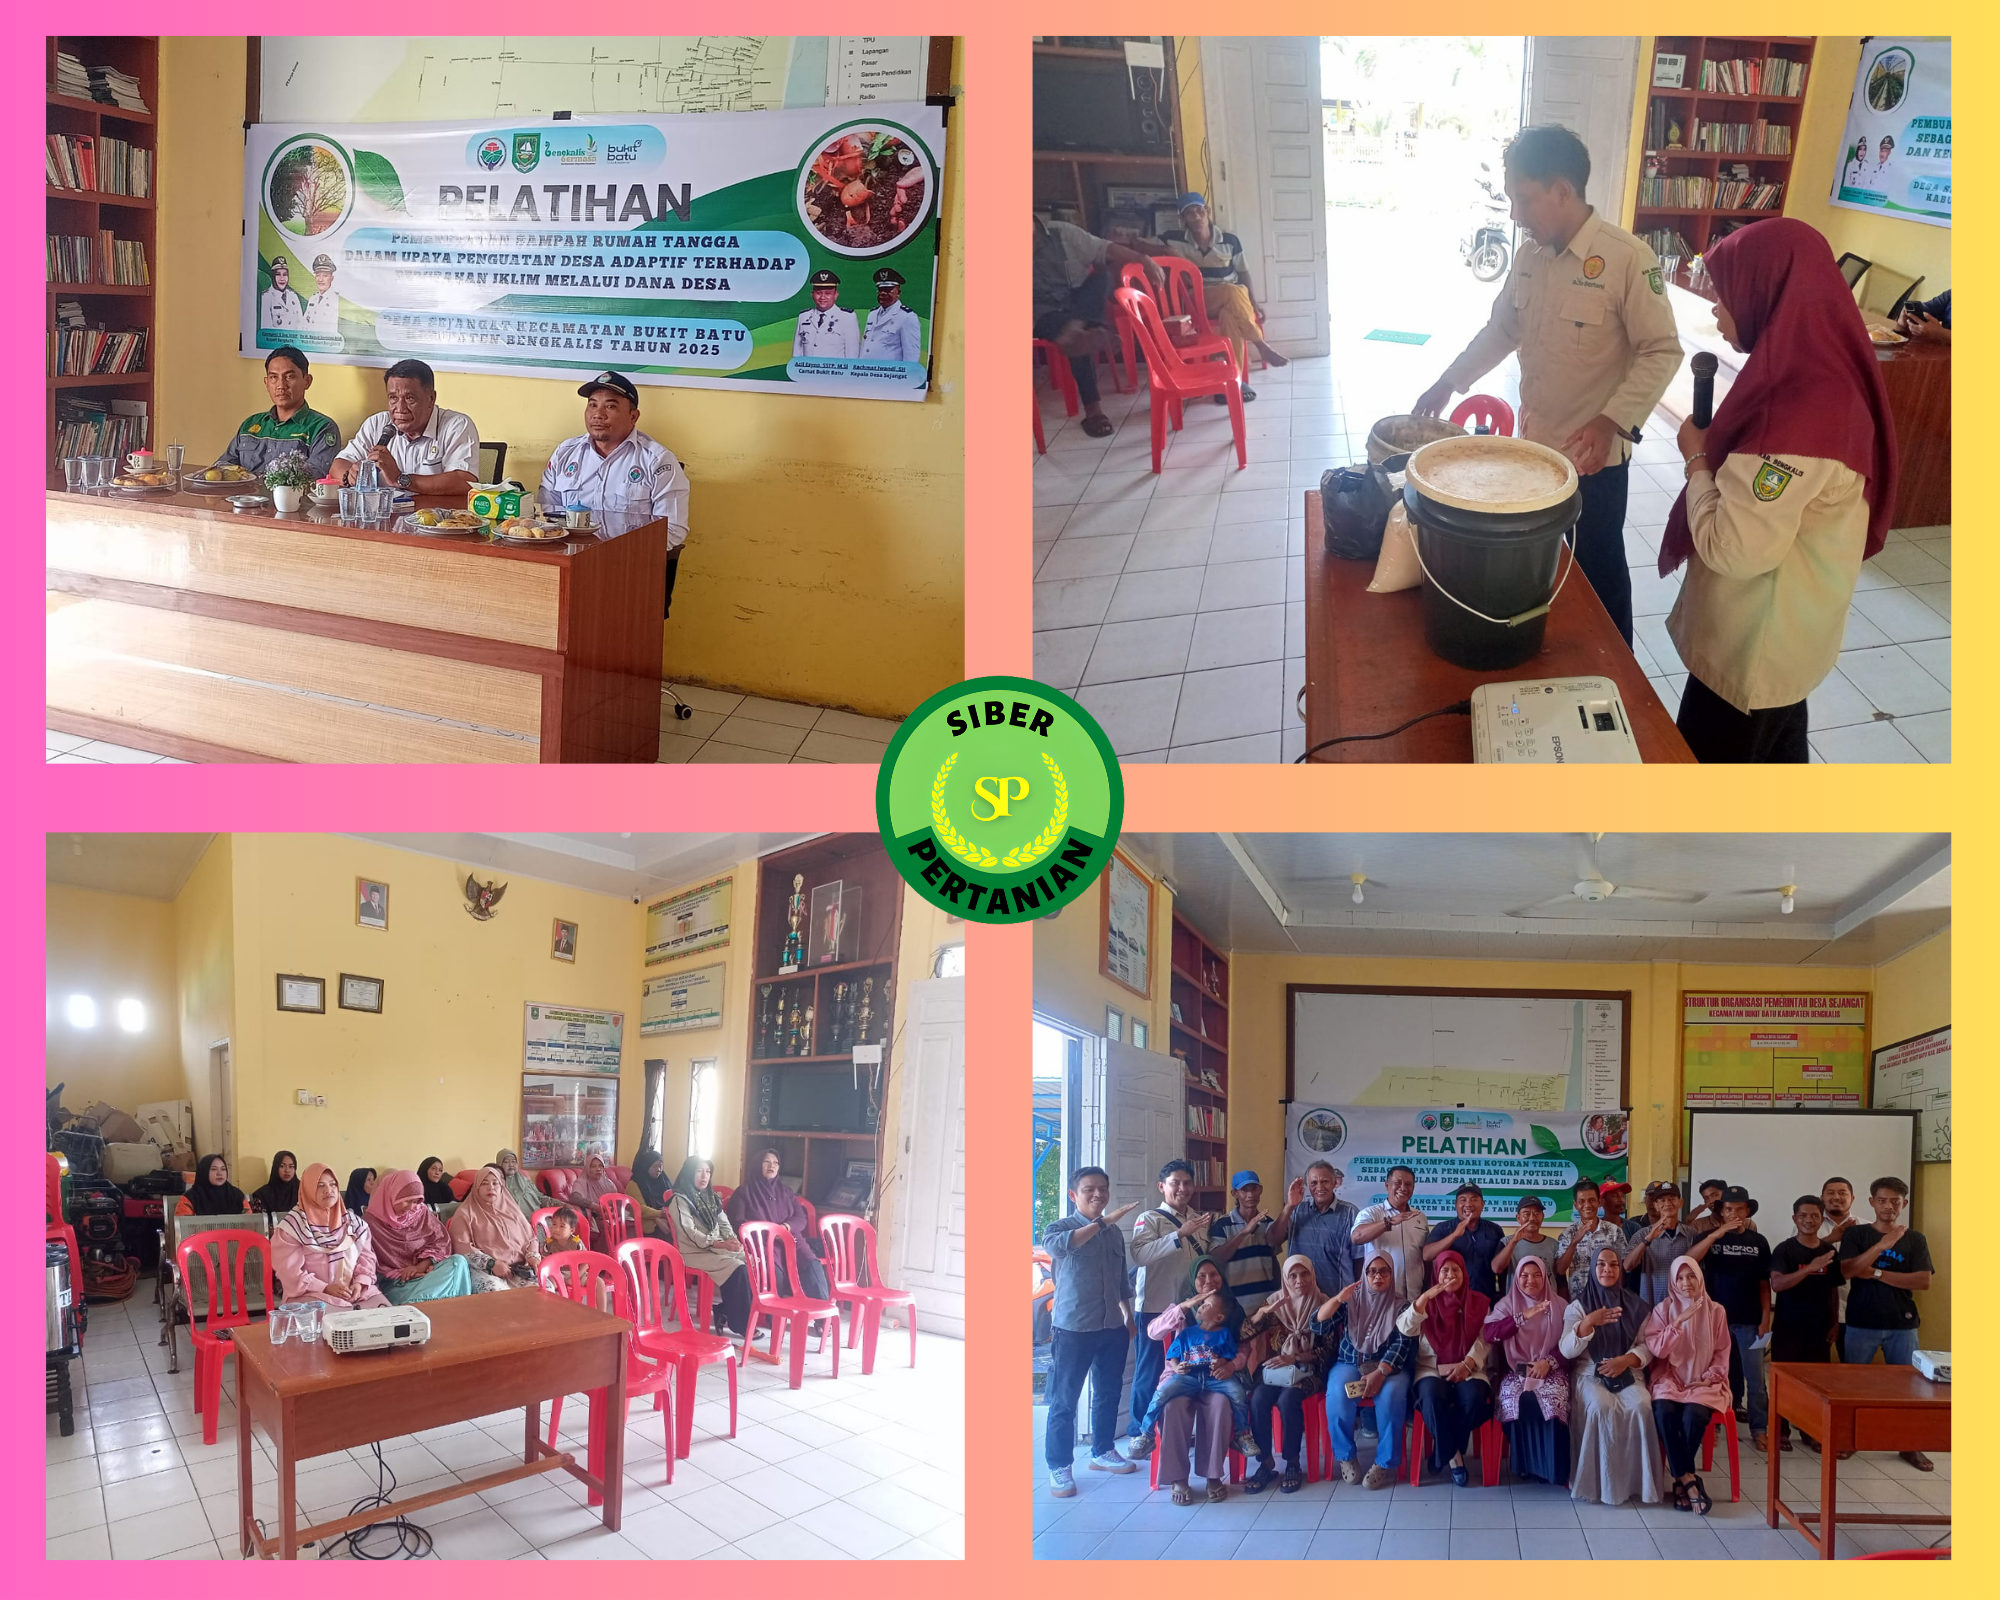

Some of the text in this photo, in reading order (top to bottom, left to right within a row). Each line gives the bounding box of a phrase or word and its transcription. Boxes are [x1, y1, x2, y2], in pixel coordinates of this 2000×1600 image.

[1906, 147, 1951, 158] DAN KE
[1913, 181, 1939, 191] DESA
[438, 183, 692, 222] PELATIHAN
[592, 235, 657, 248] RUMAH
[662, 236, 740, 249] TANGGA
[344, 249, 796, 271] DALAM UPAYA PENGUATAN DESA ADAPTIF TERHADAP
[492, 272, 541, 286] IKLIM
[544, 274, 620, 288] MELALUI
[624, 276, 676, 289] DANA
[682, 277, 731, 291] DESA
[517, 320, 626, 337] KECAMATAN
[633, 325, 689, 340] BUKIT
[694, 328, 746, 341] BATU
[506, 335, 603, 351] BENGKALIS
[610, 340, 671, 354] TAHUN
[677, 344, 720, 356] 2025
[1772, 459, 1804, 477] BENGKALIS
[1551, 735, 1565, 764] EPSON
[1684, 996, 1864, 1008] STRUKTUR ORGANISASI PEMERINTAH DESA SEJANGAT
[1708, 1010, 1841, 1018] KECAMATAN BUKIT BATU KABUPATEN BENGKALIS
[1401, 1135, 1527, 1156] PELATIHAN
[1353, 1157, 1413, 1165] PEMBUATAN
[1415, 1158, 1456, 1166] KOMPOS
[1441, 1168, 1520, 1176] PENGEMBANGAN
[1523, 1169, 1563, 1177] POTENSI
[1468, 1177, 1510, 1185] MELALUI
[1512, 1178, 1540, 1186] DANA
